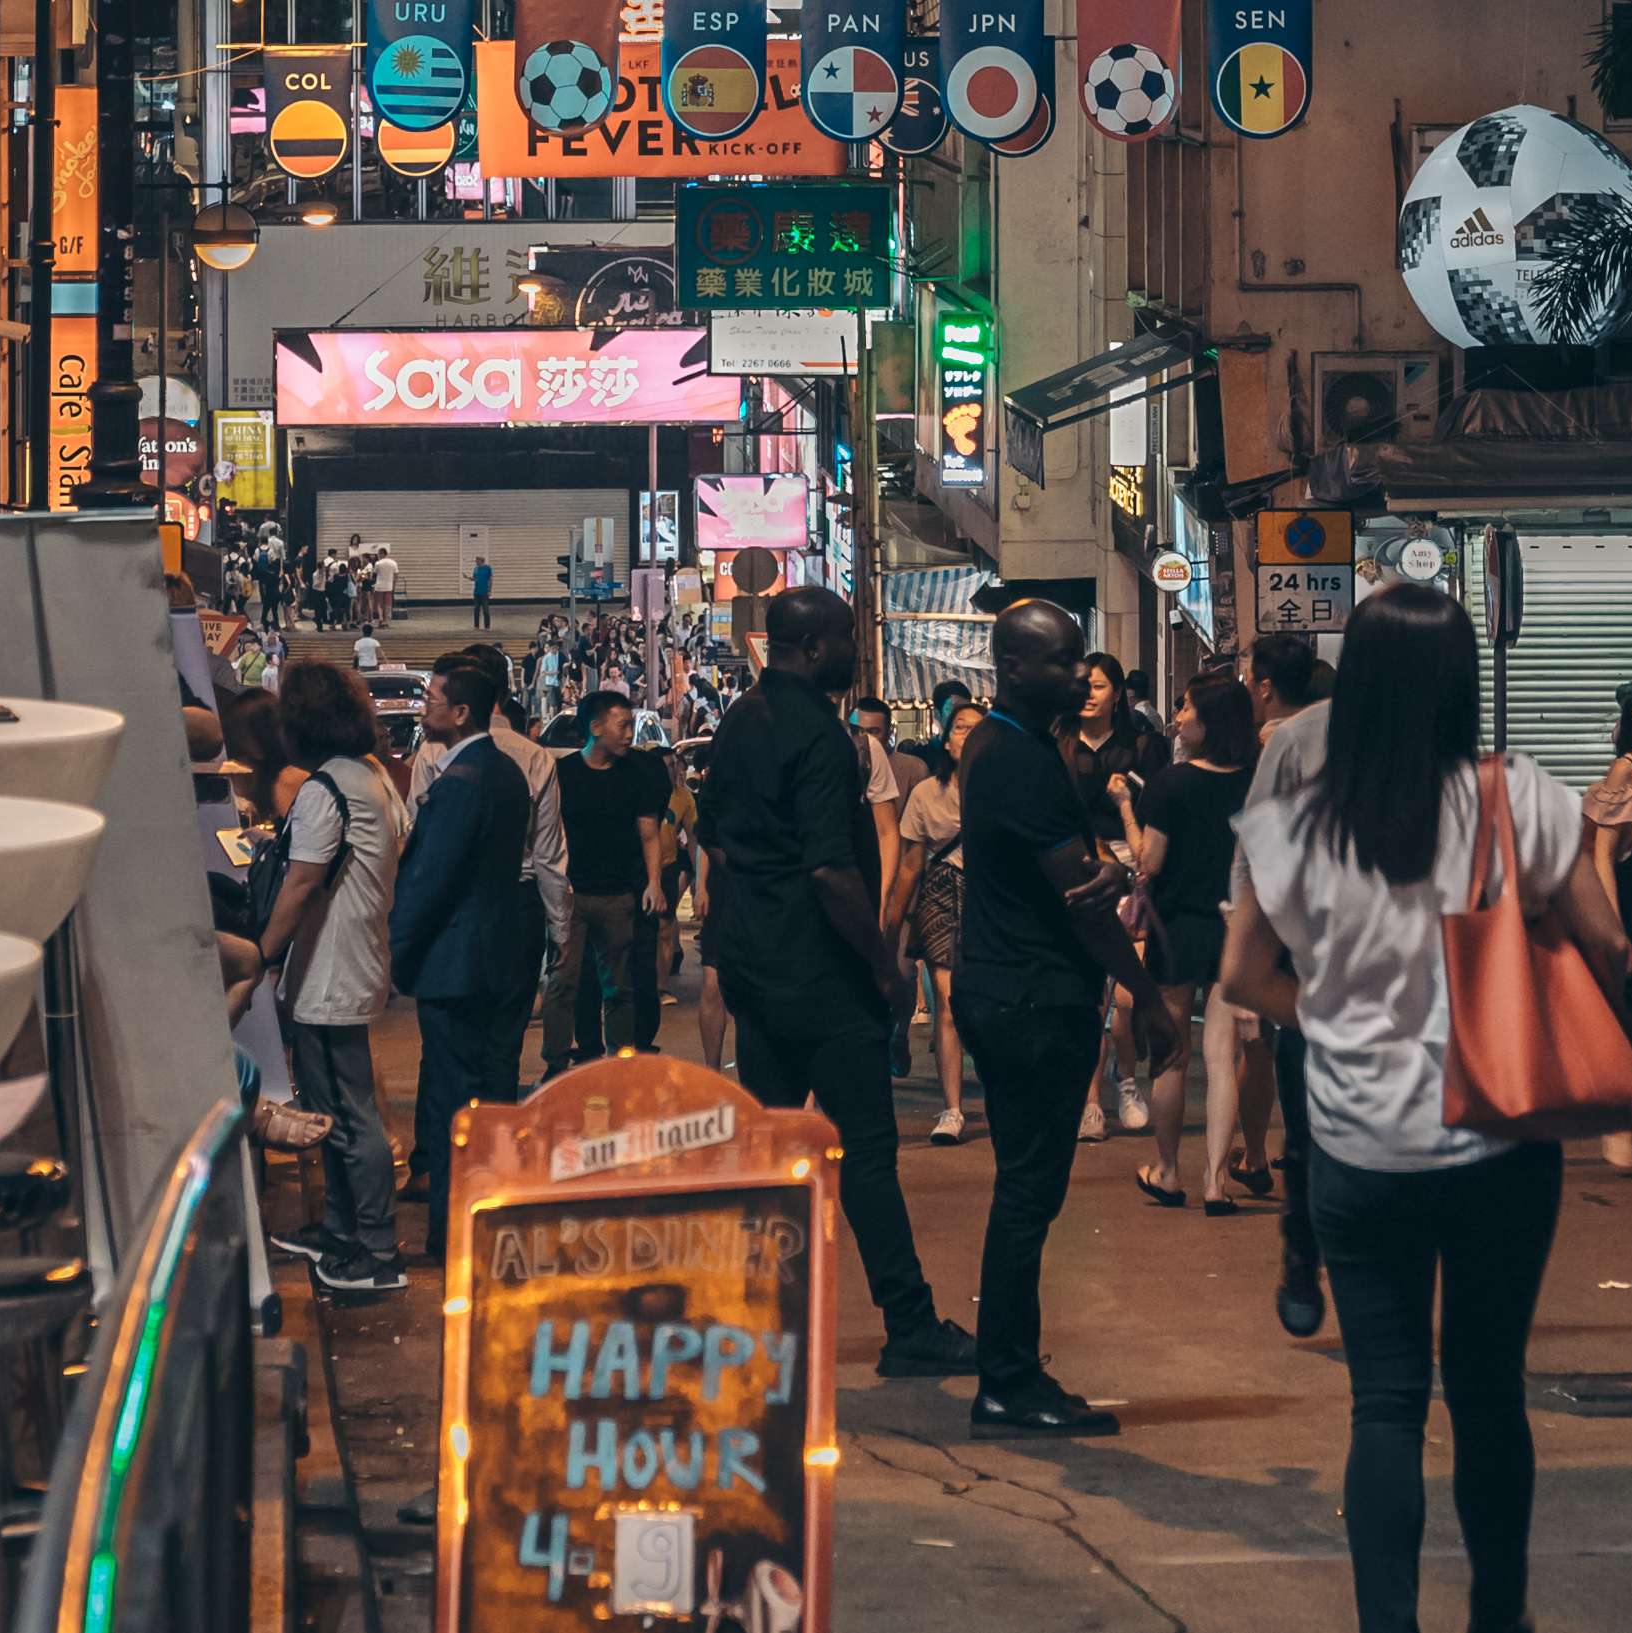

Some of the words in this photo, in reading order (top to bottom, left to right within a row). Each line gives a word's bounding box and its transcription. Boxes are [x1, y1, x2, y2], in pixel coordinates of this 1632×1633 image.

[394, 1, 447, 24] URU
[693, 11, 740, 32] ESP
[1235, 9, 1287, 29] SEN
[828, 14, 880, 33] PAN
[969, 13, 1017, 33] JPN
[628, 60, 649, 69] LKF
[904, 50, 930, 67] US
[285, 72, 332, 91] COL
[527, 120, 701, 156] FEVER
[708, 142, 803, 156] KICK-OFF
[59, 235, 84, 255] G/F
[1450, 231, 1505, 249] adidas
[536, 355, 640, 409] 莎莎
[138, 436, 198, 454] aton's
[1269, 574, 1300, 592] 24
[1306, 573, 1342, 592] hrs
[1276, 598, 1333, 624] 全日
[202, 622, 222, 631] IVE
[205, 632, 222, 642] AY
[490, 1217, 613, 1280] AL'S
[624, 1215, 807, 1284] DINER
[528, 1318, 799, 1405] HAPPY
[566, 1417, 767, 1494] HOUR
